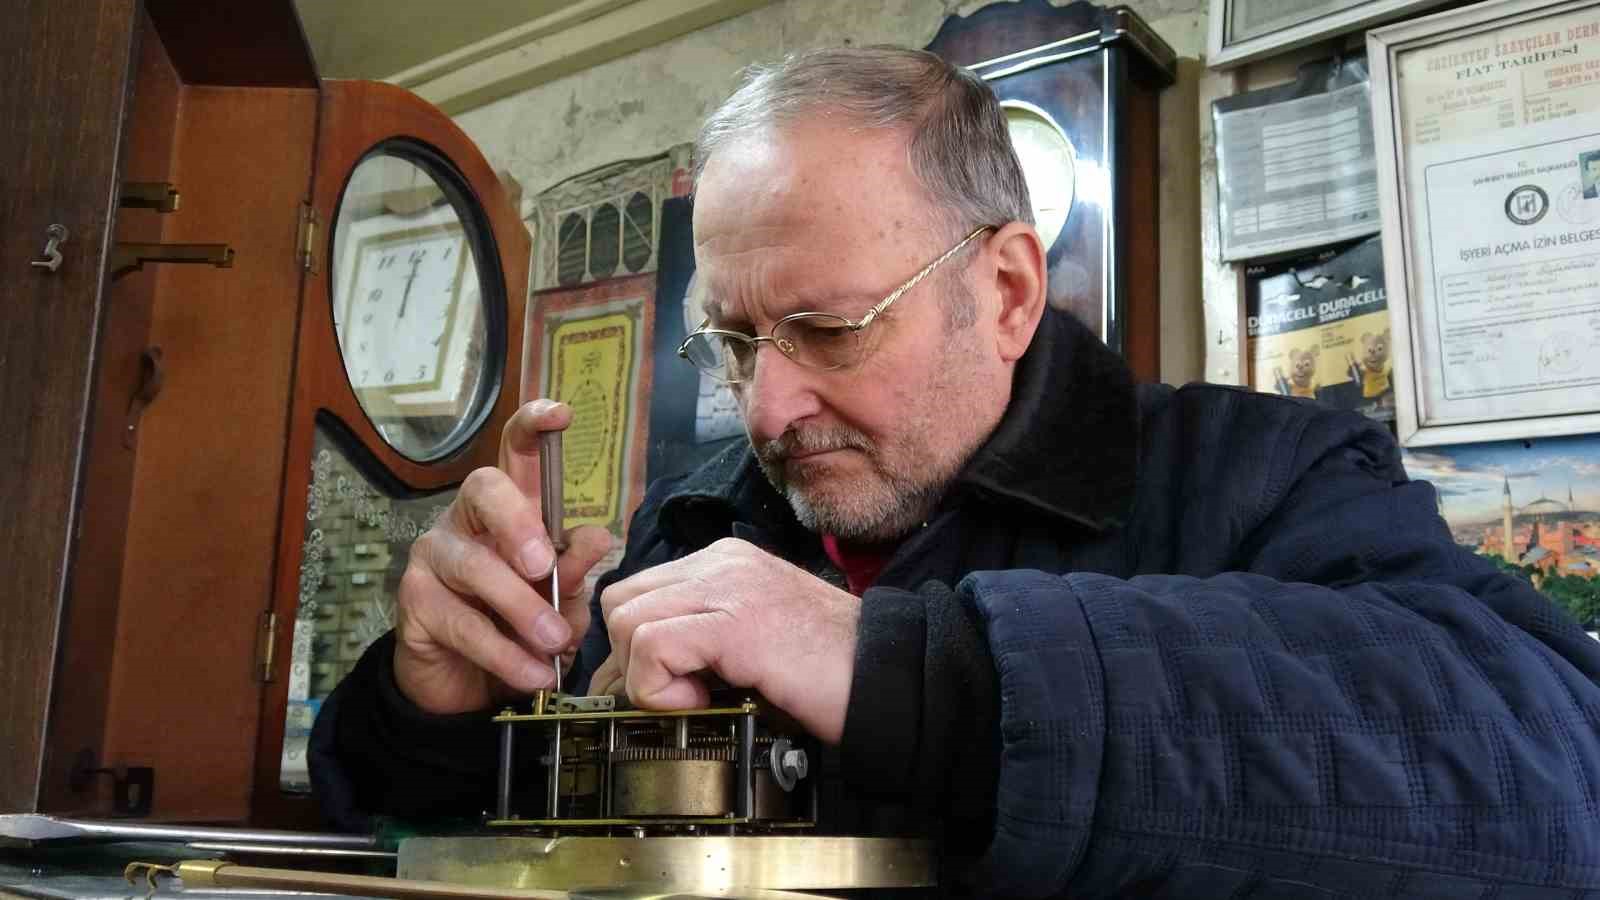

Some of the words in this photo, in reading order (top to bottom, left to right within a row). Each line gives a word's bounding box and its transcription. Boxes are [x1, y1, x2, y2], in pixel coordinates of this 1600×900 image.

[1495, 240, 1531, 255] AÇMA
[1319, 288, 1387, 314] DURACELL
[1247, 305, 1316, 328] DURACELL
[1320, 309, 1351, 323] SIMPLY
